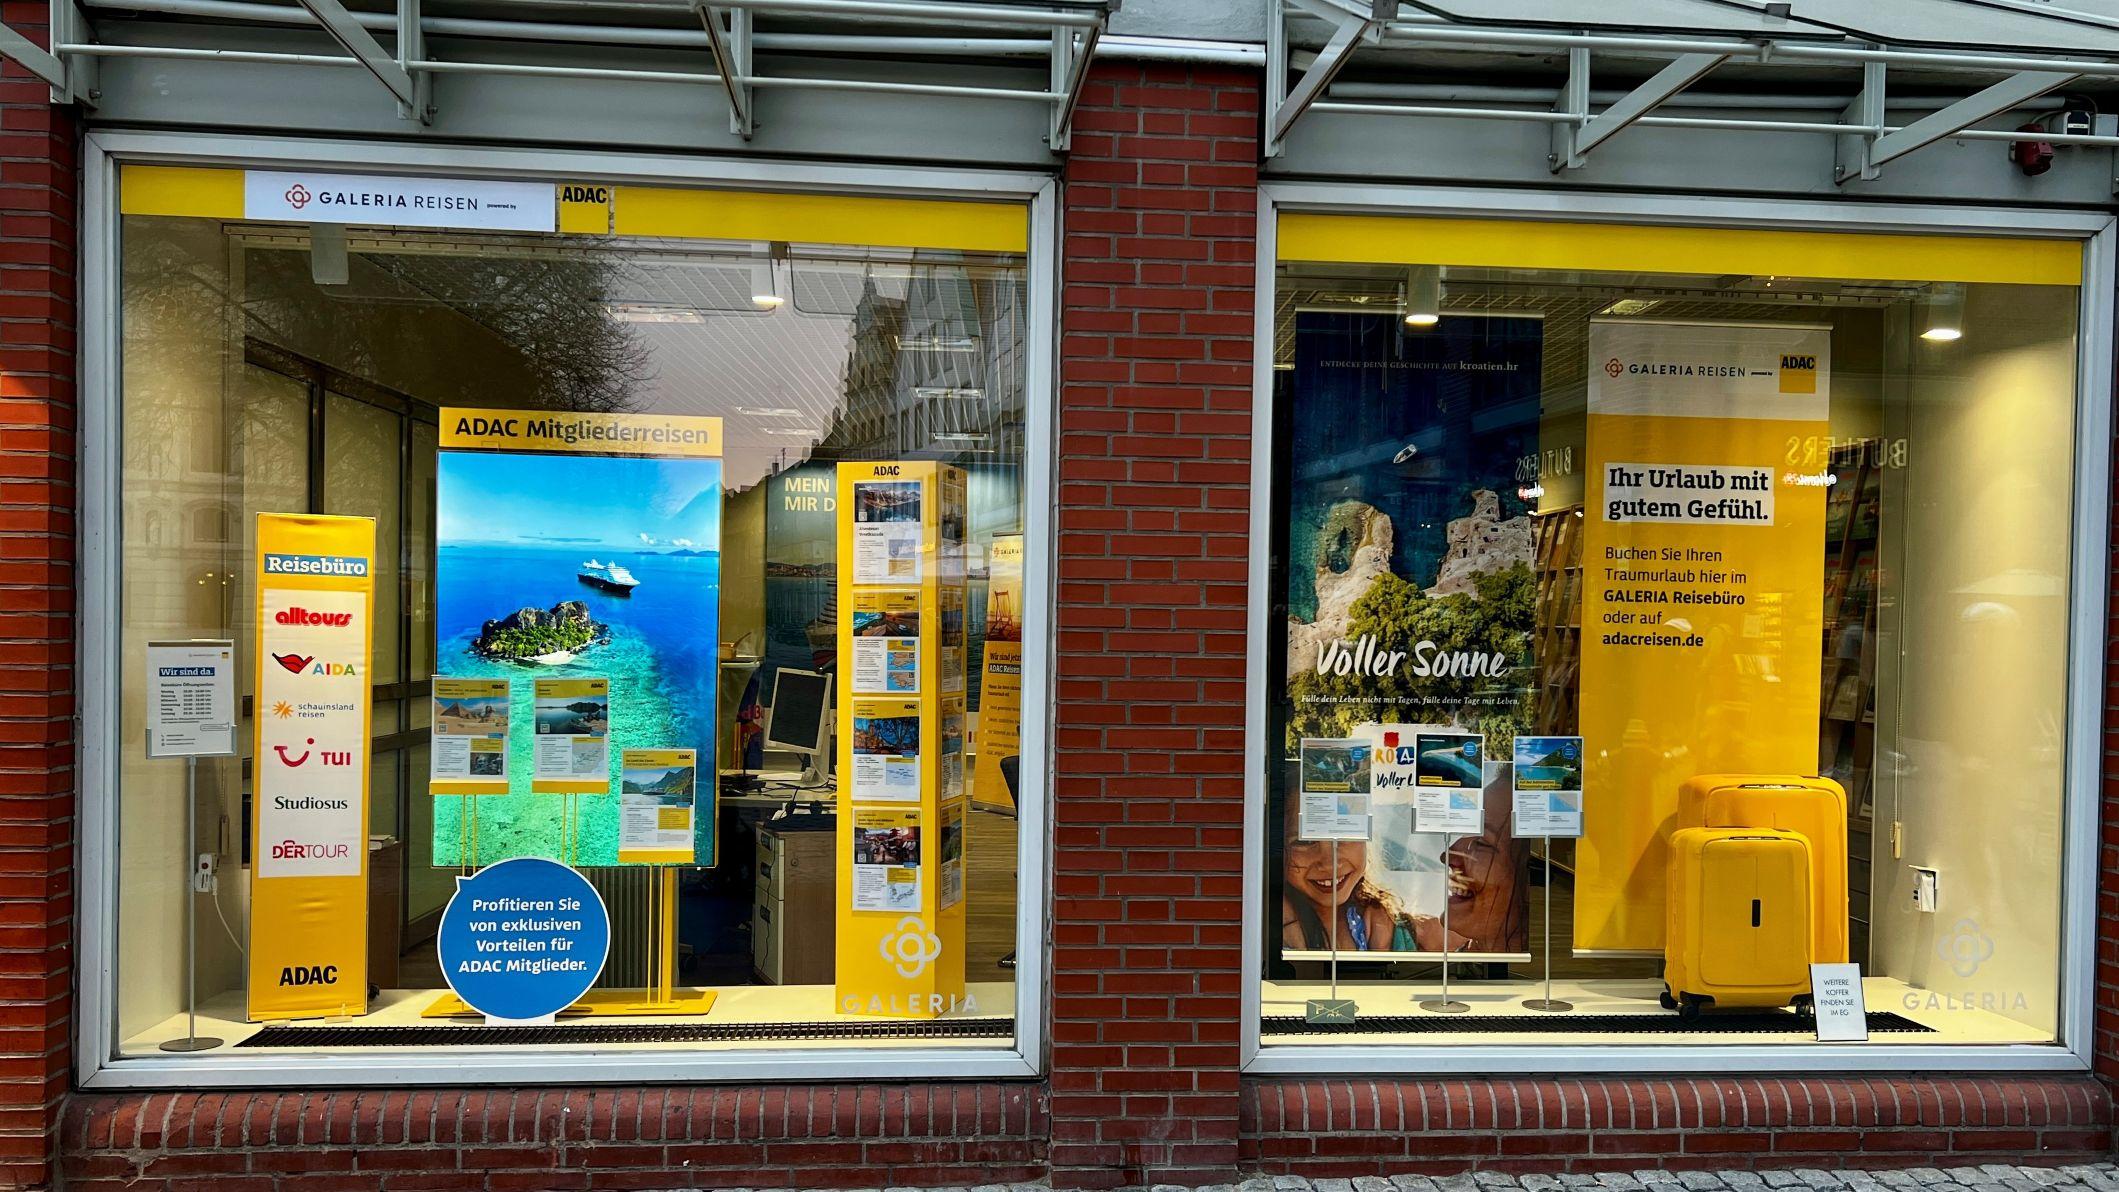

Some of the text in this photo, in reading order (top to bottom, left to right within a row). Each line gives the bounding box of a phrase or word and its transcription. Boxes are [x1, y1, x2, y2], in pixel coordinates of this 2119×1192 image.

[319, 192, 407, 207] GALERIA
[414, 196, 478, 210] REISEN
[562, 186, 607, 204] ADAC
[1390, 361, 1440, 369] GESCHICHTE
[1460, 361, 1519, 371] kroatien.hr
[1629, 364, 1693, 376] GALERIA
[1698, 366, 1746, 377] REISEN
[1781, 356, 1814, 370] ADAC
[455, 418, 708, 444] ADAC Mitgliederreisen
[873, 466, 900, 476] ADAC
[785, 477, 829, 493] MEIN
[1609, 468, 1768, 490] Ihr Urlaub mit
[785, 496, 836, 512] MIR D
[1609, 499, 1768, 520] gutem Gefühl.
[1605, 547, 1721, 562] Buchen Sie Ihren
[268, 557, 365, 574] Reisebüro
[1605, 568, 1746, 583] Traumurlaub hier im
[1604, 590, 1745, 605] GALERIA Reisebüro
[275, 607, 352, 627] alltours
[1603, 611, 1662, 624] oder auf
[1603, 632, 1703, 646] adacreisen.de
[1316, 634, 1508, 678] Voller Sonne
[179, 667, 198, 675] sind
[200, 667, 213, 675] da.
[312, 663, 356, 675] AIDA
[989, 665, 1003, 673] ADAC
[298, 703, 354, 711] schauinsland
[1301, 694, 1519, 705] Fülle dein Leben nicht mit Tagen, fülle deine Tage mit Leben.
[321, 752, 350, 765] TUI
[1377, 772, 1406, 789] Voller
[275, 796, 347, 810] Studiosus
[472, 898, 580, 912] Profitieren Sie
[469, 918, 581, 932] von exklusiven
[476, 938, 573, 952] Vorteilen für
[459, 958, 587, 974] ADAC Mitglieder.
[280, 965, 337, 986] ADAC
[842, 993, 979, 1014] GALERIA
[1903, 991, 2028, 1010] GALERIA
